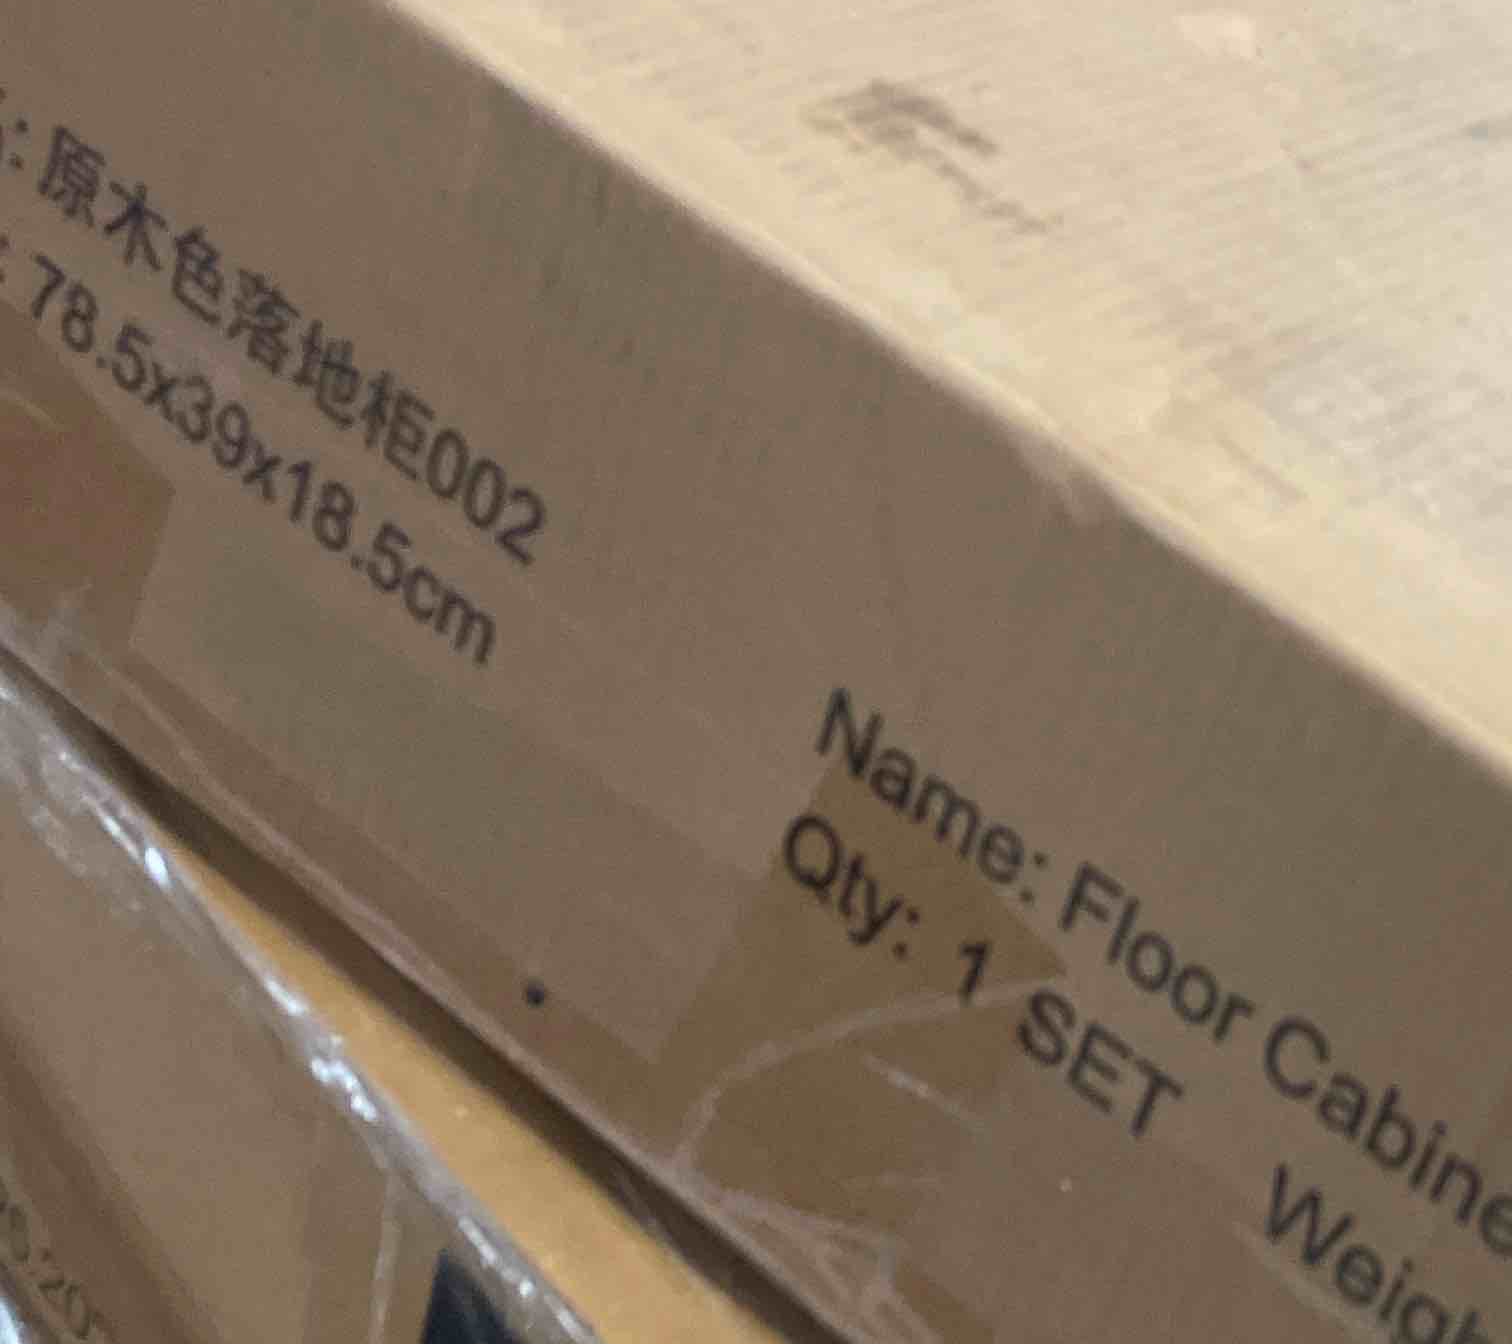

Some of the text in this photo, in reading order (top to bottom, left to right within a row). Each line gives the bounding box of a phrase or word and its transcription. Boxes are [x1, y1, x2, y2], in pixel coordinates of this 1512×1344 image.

[30, 252, 499, 664] 78.5x39x18.5cm
[38, 125, 549, 567] 原木色落地柜002
[782, 813, 921, 959] Qty:
[957, 940, 992, 1004] 1
[1016, 987, 1184, 1140] SET
[816, 687, 1048, 904] Name:
[1059, 860, 1256, 1044] Floor
